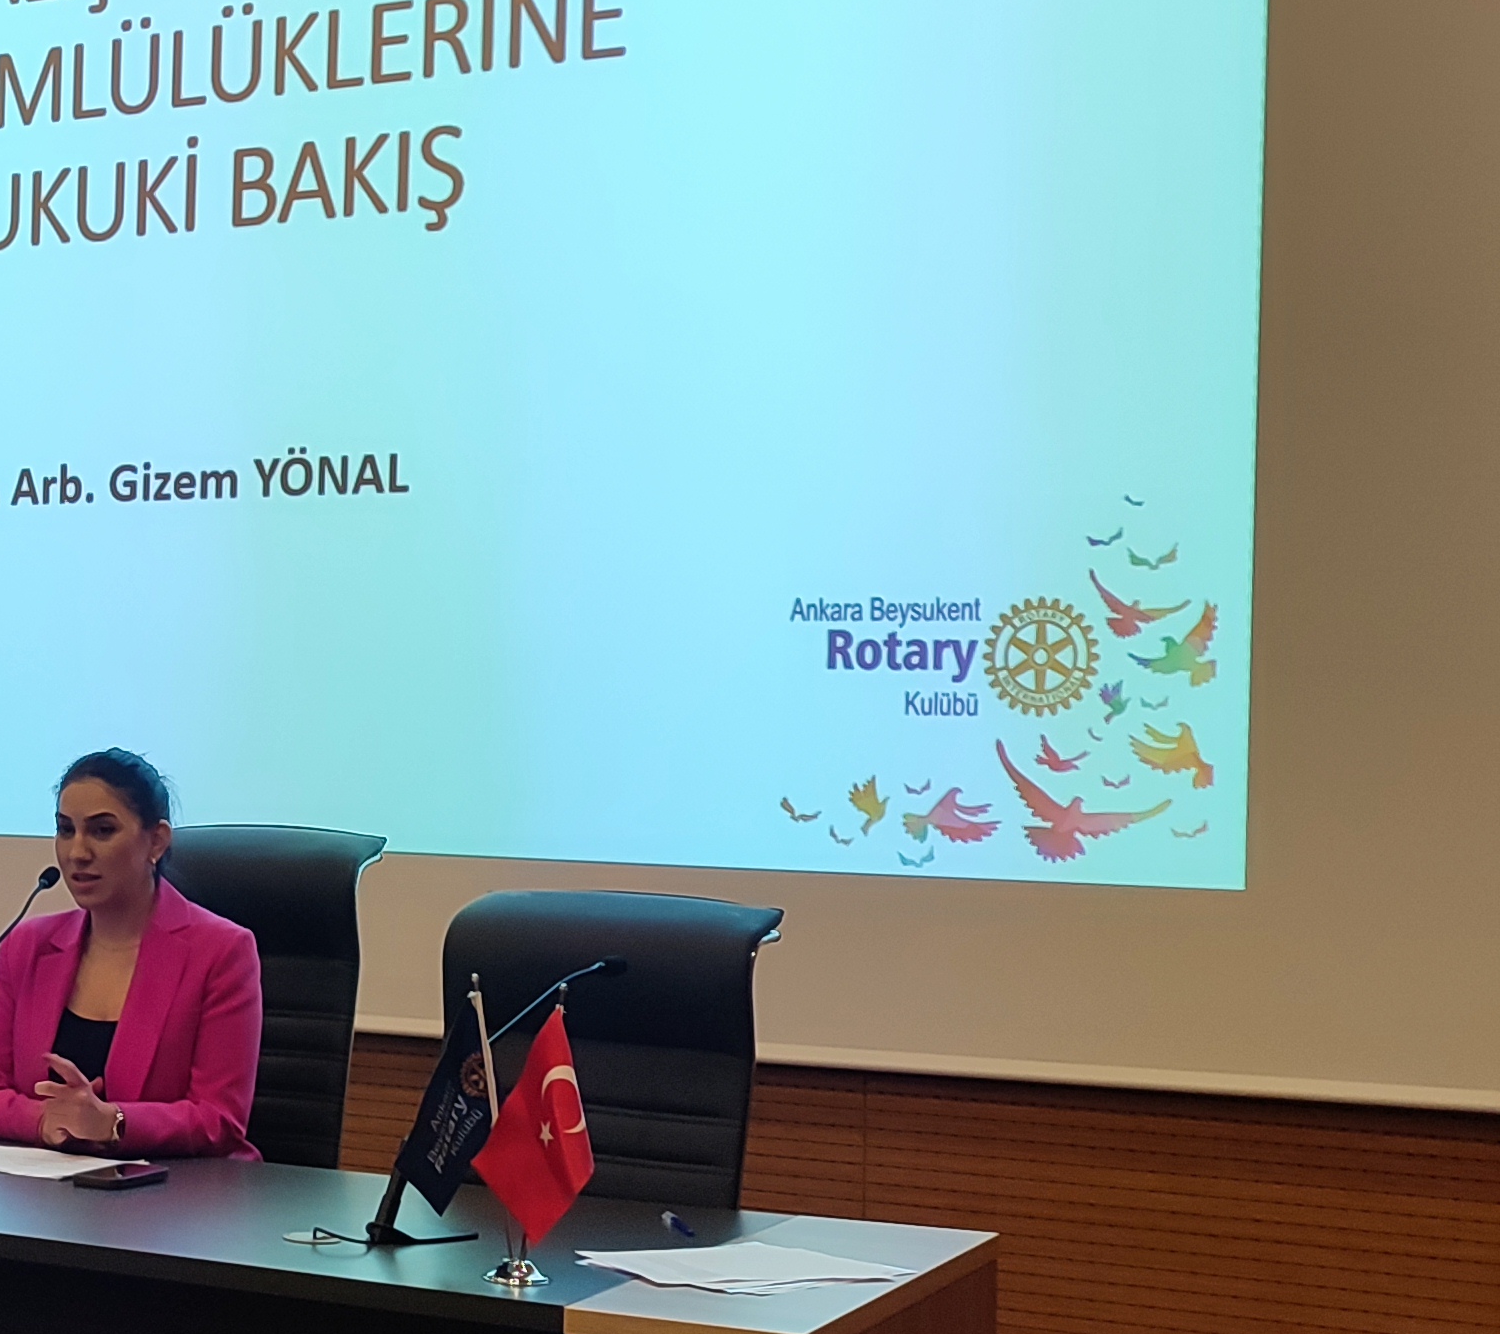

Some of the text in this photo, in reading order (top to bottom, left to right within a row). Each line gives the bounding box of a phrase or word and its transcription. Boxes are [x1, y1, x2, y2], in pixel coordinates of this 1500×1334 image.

[231, 123, 466, 232] BAKIŞ
[10, 463, 94, 505] Arb.
[109, 461, 238, 502] Gizem
[253, 446, 411, 498] YÖNAL
[789, 596, 982, 628] Ankara Beysukent
[826, 629, 979, 683] Rotary
[904, 690, 979, 717] Kulübü
